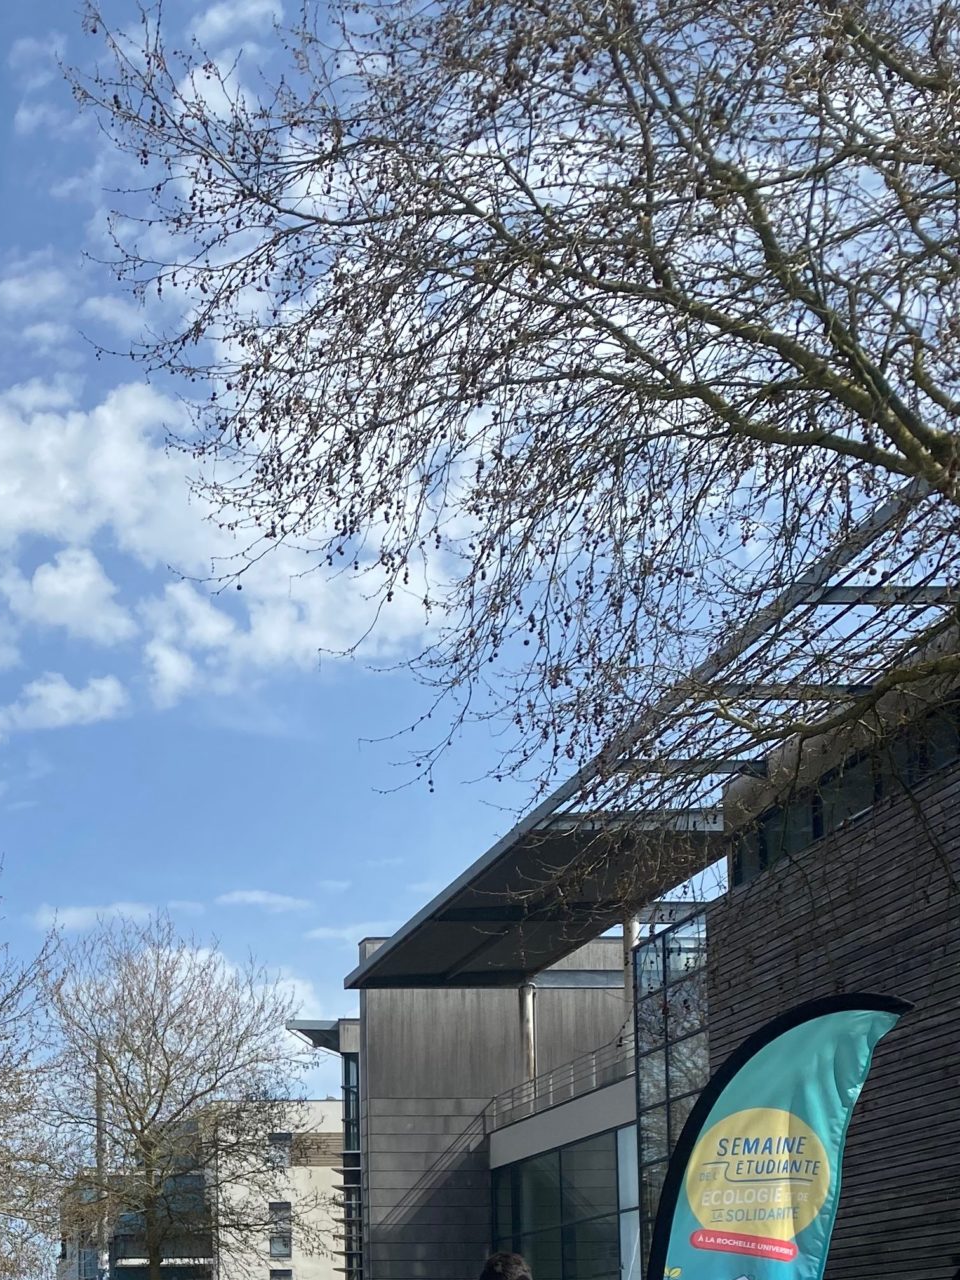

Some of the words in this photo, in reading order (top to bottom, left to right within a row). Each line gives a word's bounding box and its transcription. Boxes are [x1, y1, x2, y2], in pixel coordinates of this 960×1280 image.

[716, 1135, 807, 1157] SEMAINE
[705, 1236, 715, 1244] LA
[716, 1237, 756, 1249] ROCHELLE
